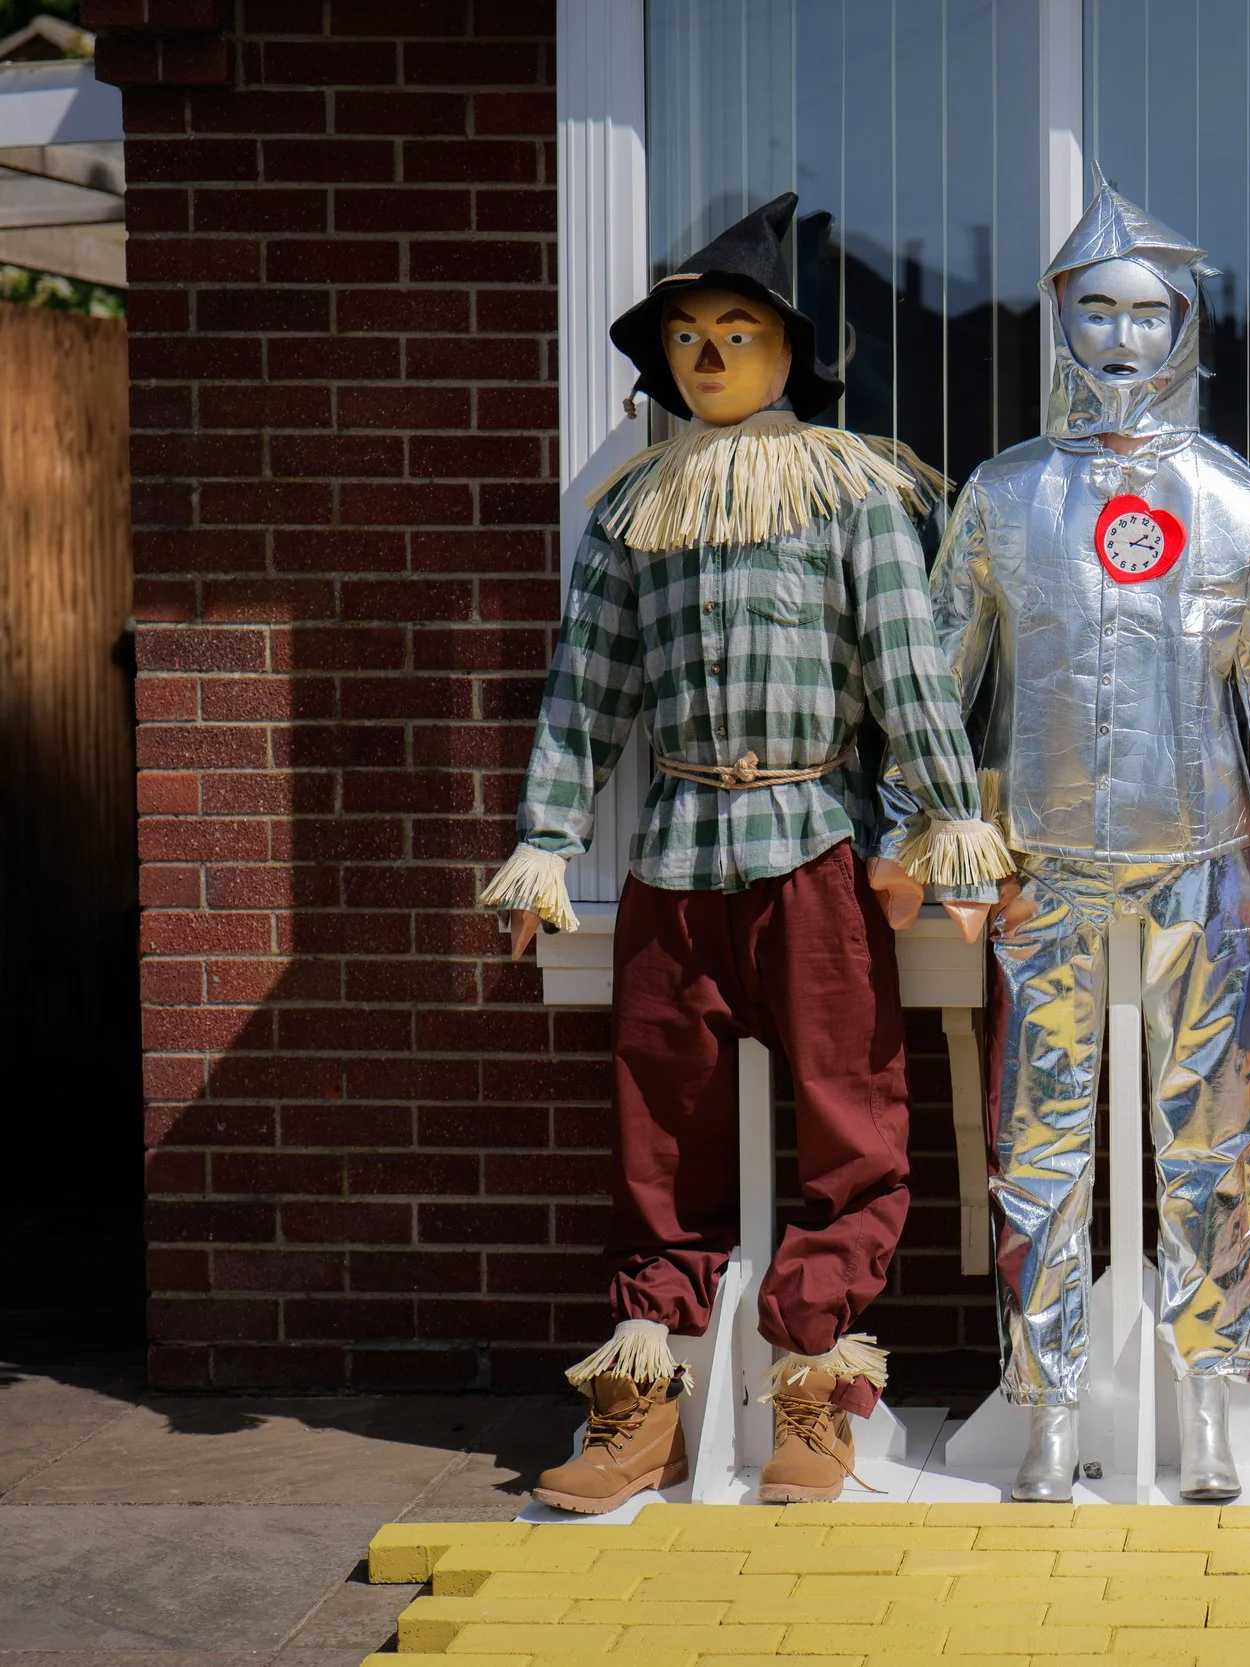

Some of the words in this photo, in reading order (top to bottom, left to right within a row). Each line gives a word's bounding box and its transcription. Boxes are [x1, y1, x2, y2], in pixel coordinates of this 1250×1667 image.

[1119, 520, 1127, 528] 10
[1130, 516, 1137, 524] 11
[1142, 518, 1149, 526] 12
[1155, 536, 1160, 544] 2
